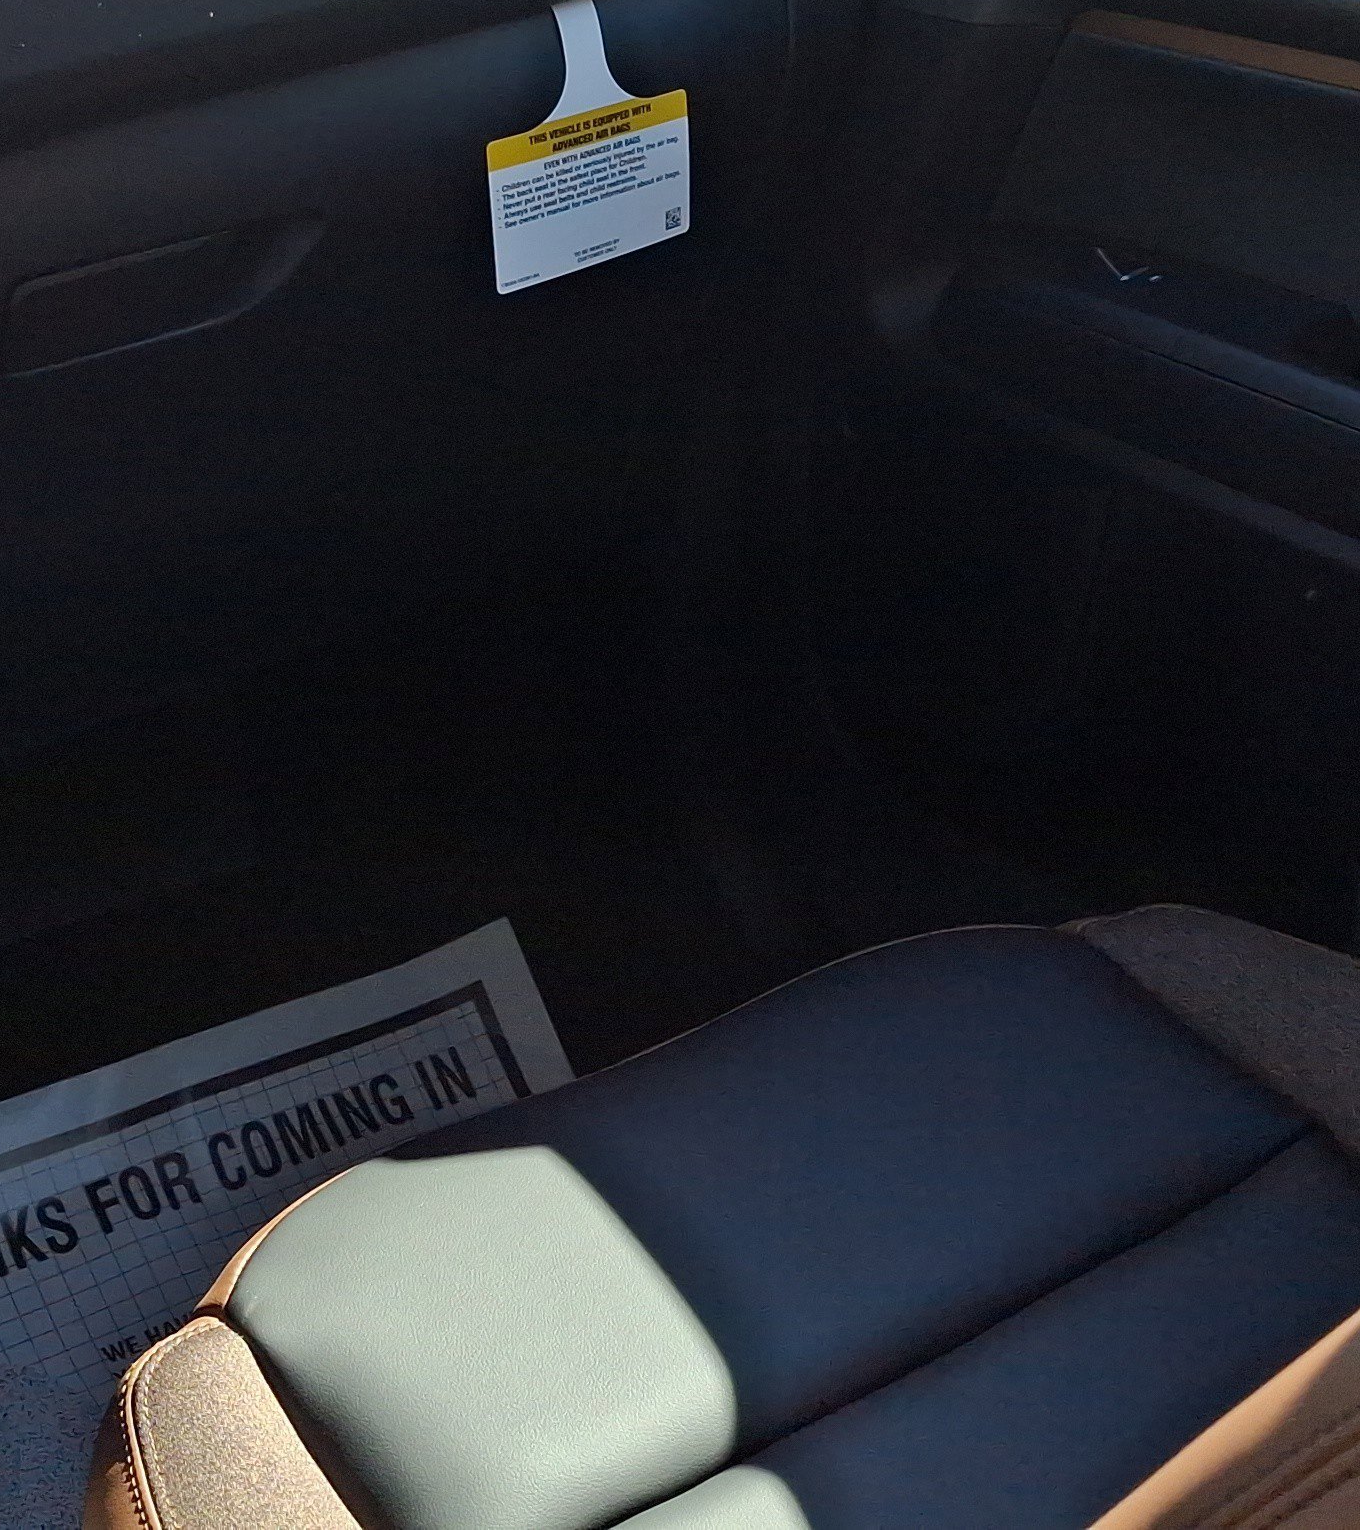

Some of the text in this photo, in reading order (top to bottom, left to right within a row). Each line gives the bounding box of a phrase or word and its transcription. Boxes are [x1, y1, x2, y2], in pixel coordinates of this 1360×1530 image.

[529, 103, 652, 145] THIS VEHICLE IS EQUIPPED WITH
[552, 123, 631, 152] ADVANCED AIR BAGS
[562, 154, 578, 164] WITH
[580, 144, 611, 160] ADVANCED
[613, 141, 623, 150] AIR
[625, 135, 641, 147] BAGS
[84, 1150, 202, 1235] FOR
[206, 1073, 415, 1192] COMING
[412, 1045, 478, 1112] IN
[100, 1334, 142, 1363] WE
